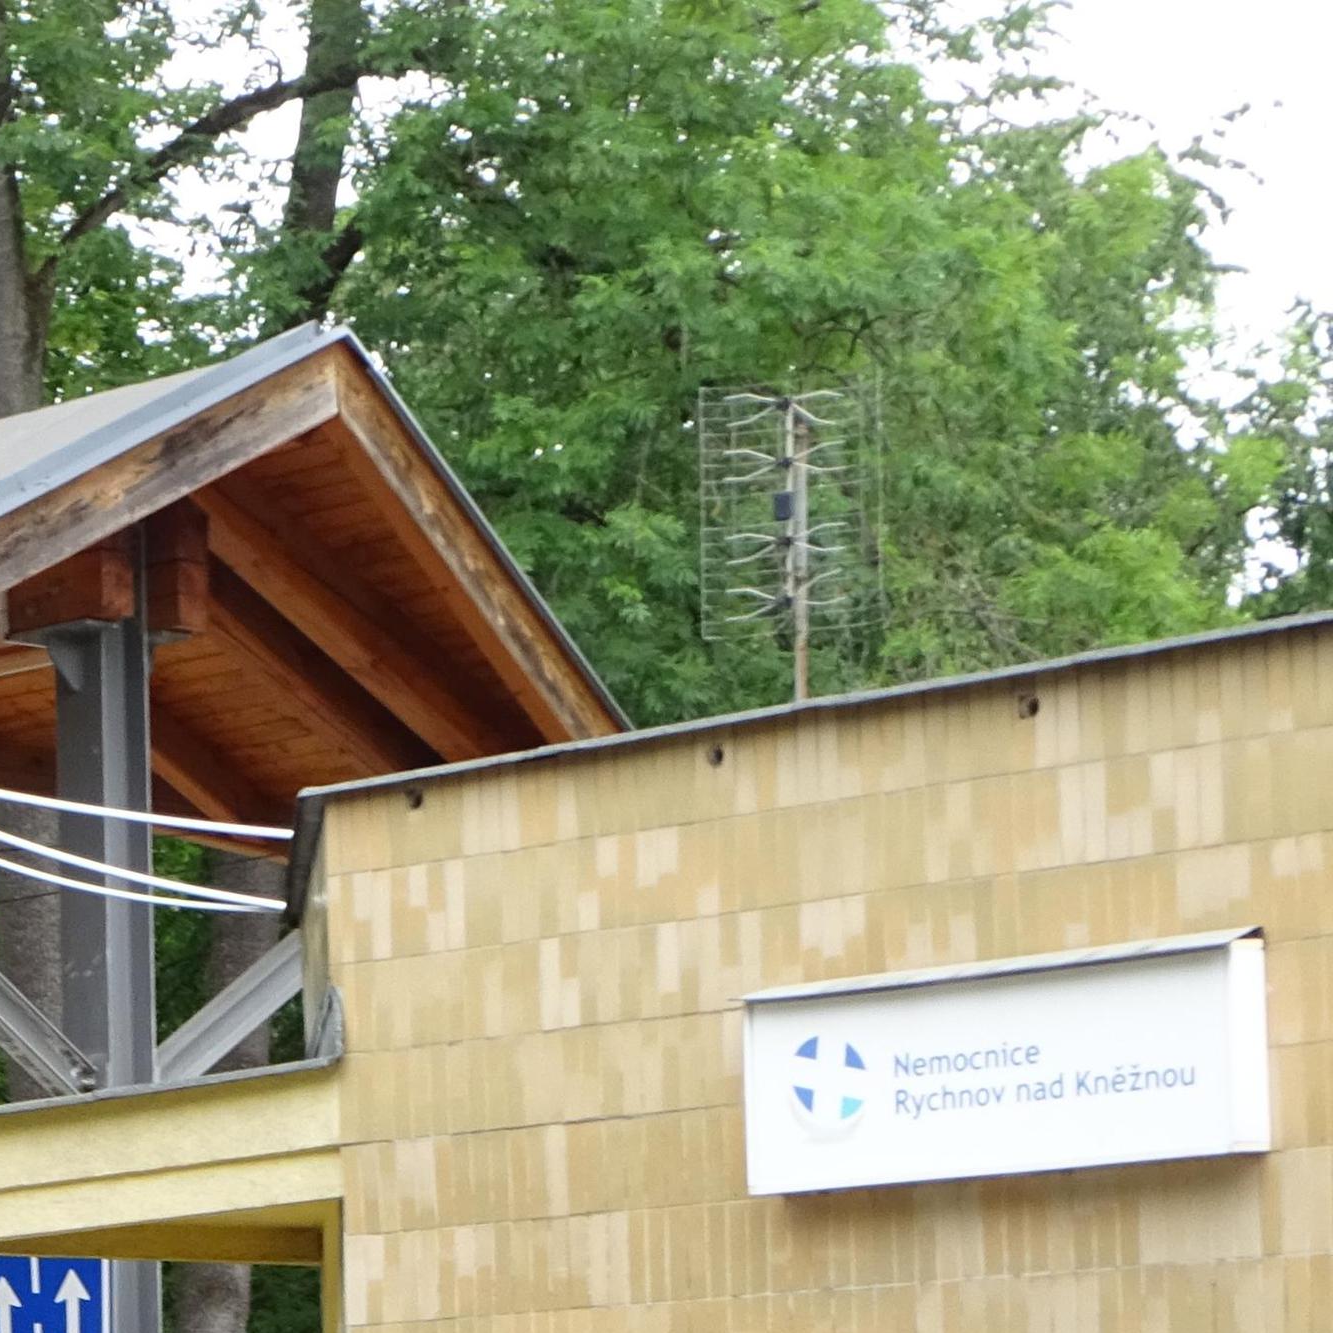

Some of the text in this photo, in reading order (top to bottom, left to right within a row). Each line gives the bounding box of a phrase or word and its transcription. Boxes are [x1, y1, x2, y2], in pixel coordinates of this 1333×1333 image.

[893, 1041, 1041, 1078] Nemocnice
[895, 1064, 1195, 1120] Rychnov nad Kněžnou
